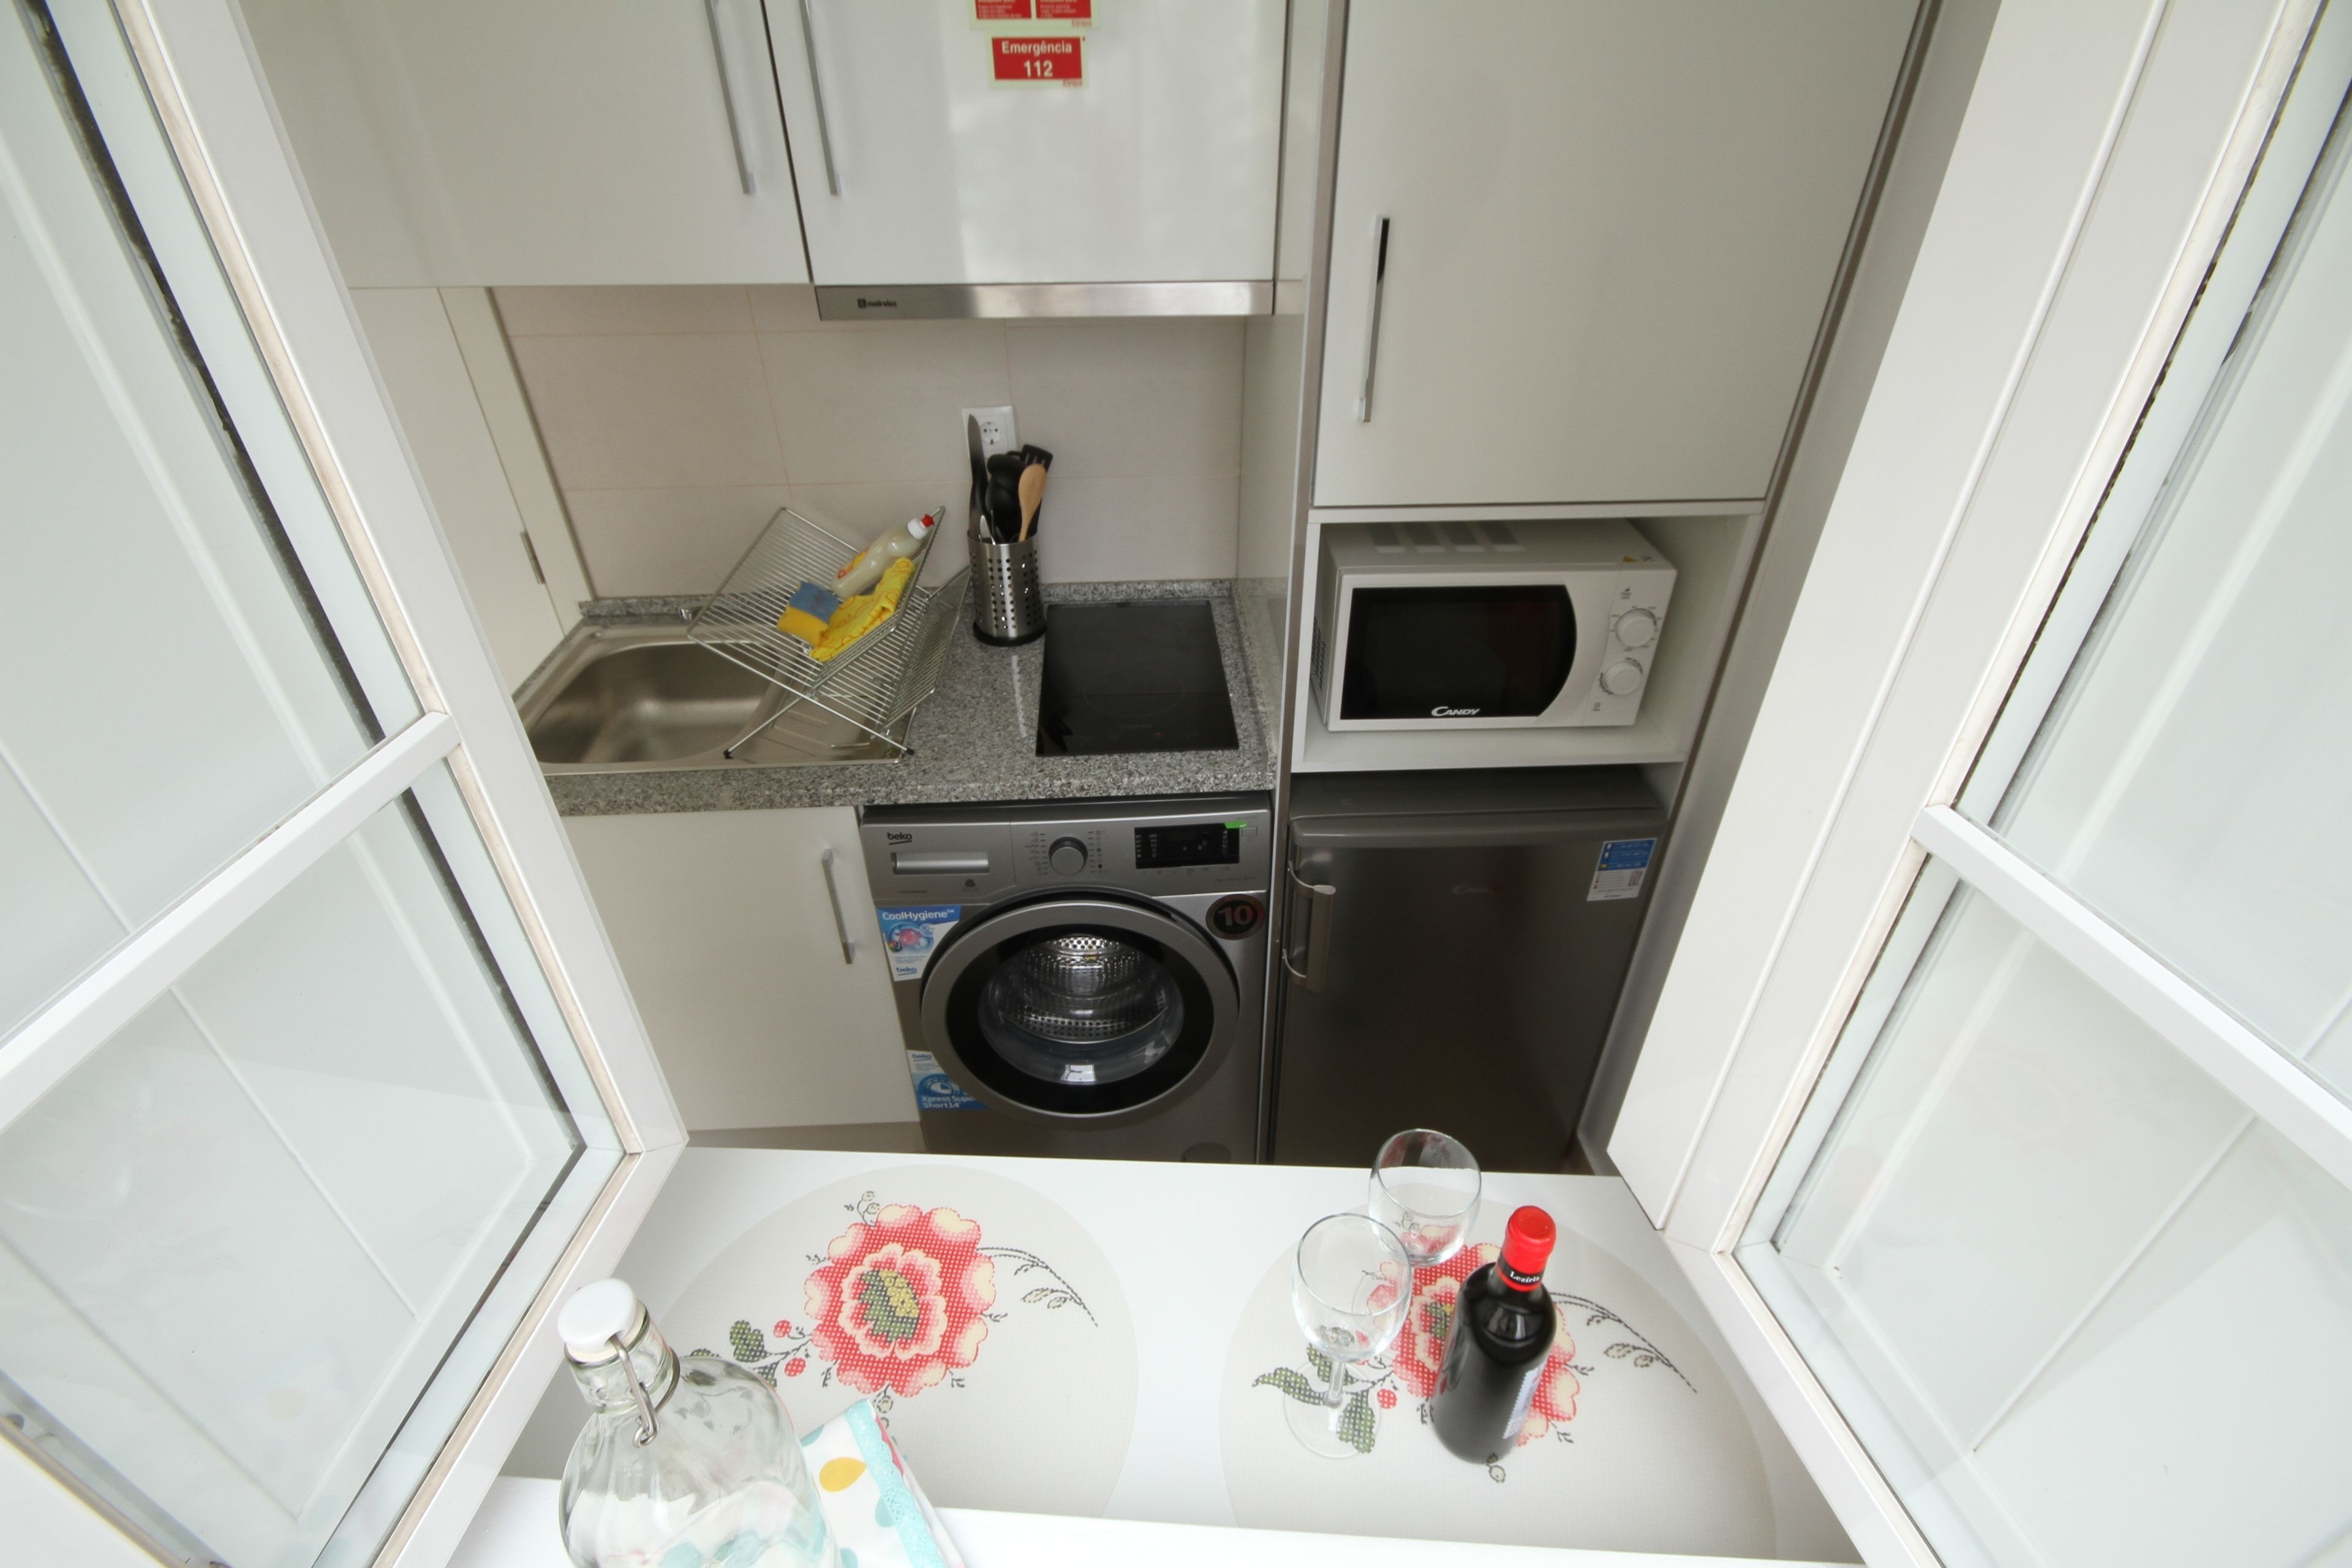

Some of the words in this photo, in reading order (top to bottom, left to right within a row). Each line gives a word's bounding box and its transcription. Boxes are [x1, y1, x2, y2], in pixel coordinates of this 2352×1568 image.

[1001, 40, 1072, 56] Emergência
[1024, 60, 1054, 77] 112
[1431, 706, 1480, 717] CANDY
[1217, 905, 1253, 926] 10
